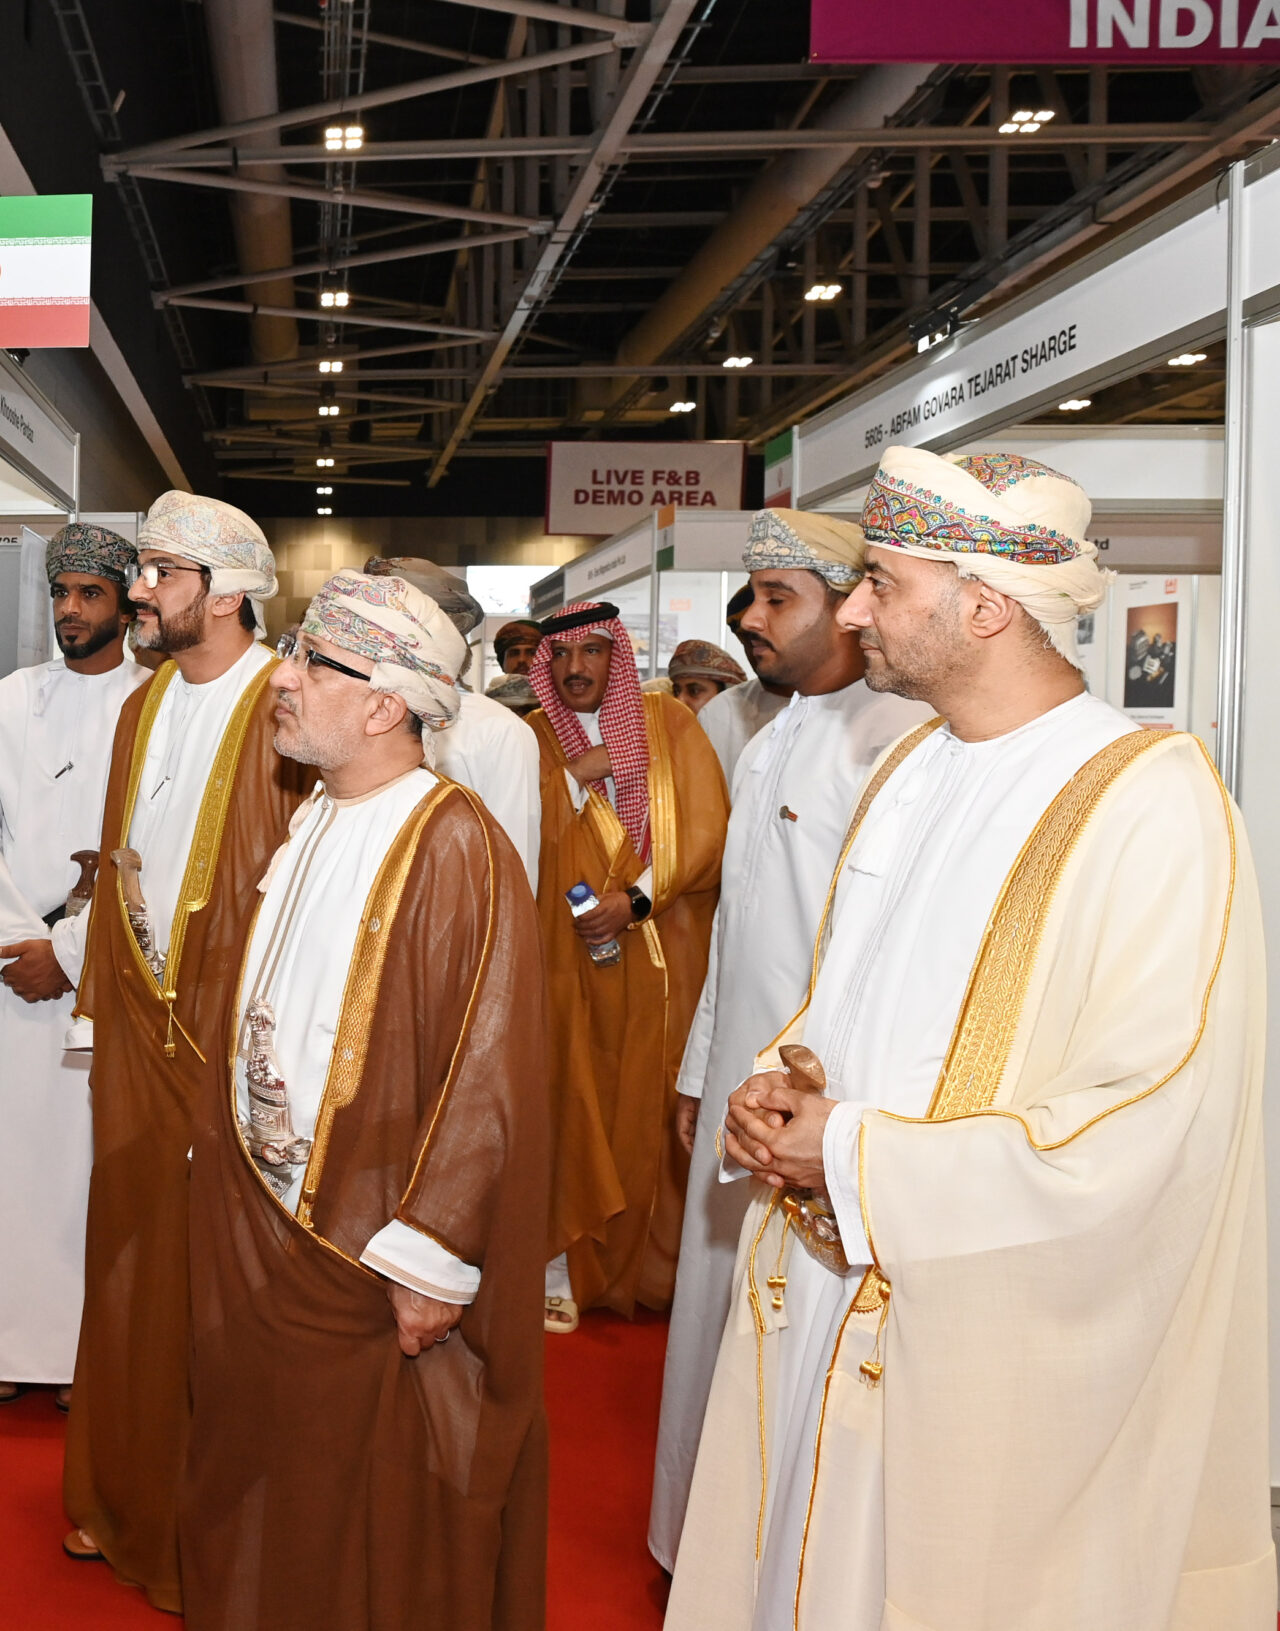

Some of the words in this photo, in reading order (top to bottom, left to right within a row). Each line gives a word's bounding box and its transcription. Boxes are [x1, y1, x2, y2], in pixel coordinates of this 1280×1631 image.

[1069, 0, 1280, 48] INDIA
[889, 404, 921, 437] ABFAM
[923, 386, 965, 420] GOVARA
[967, 355, 1019, 399] TEJARAT
[1020, 324, 1077, 374] SHARGE
[591, 469, 645, 486] LIVE
[652, 470, 701, 486] F&B
[574, 489, 644, 506] DEMO
[650, 490, 717, 506] AREA
